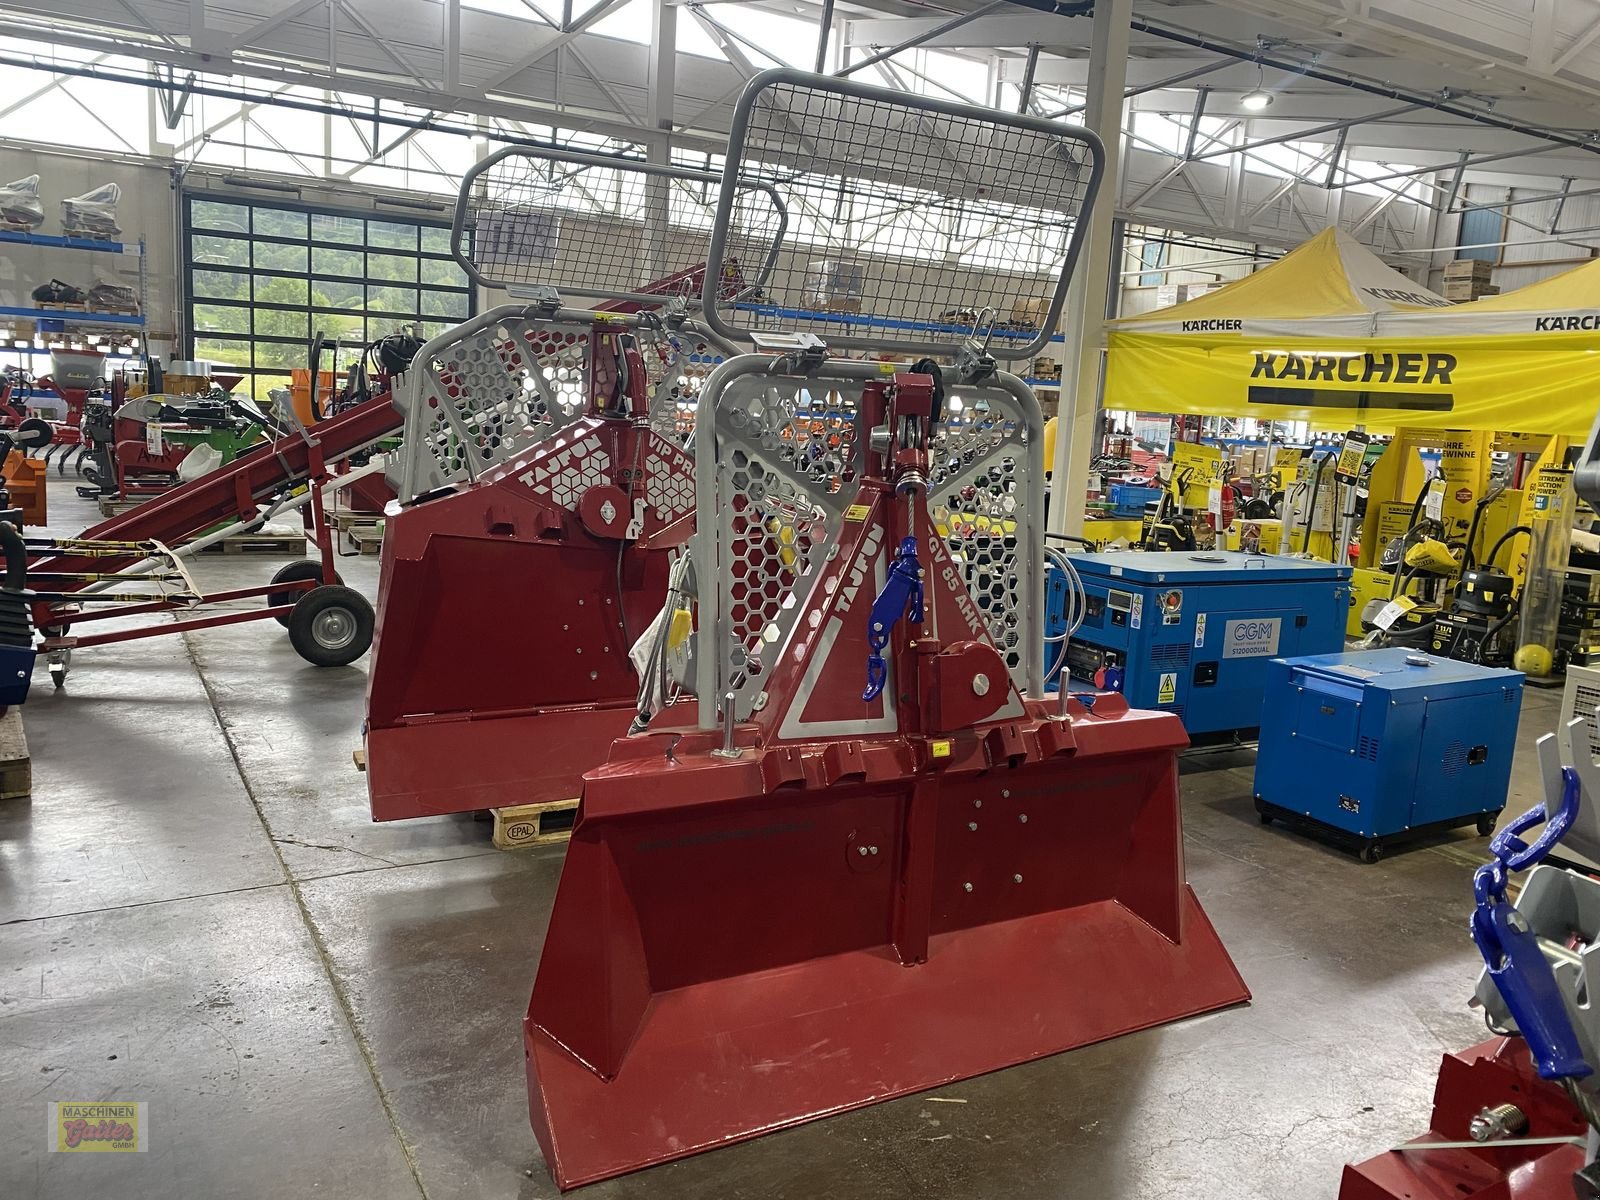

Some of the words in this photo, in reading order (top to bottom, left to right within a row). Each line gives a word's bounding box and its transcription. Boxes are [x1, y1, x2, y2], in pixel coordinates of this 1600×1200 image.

[1182, 319, 1243, 332] KÄRCHER
[648, 433, 672, 457] VIP
[518, 433, 602, 488] TAJFUN
[834, 522, 885, 613] TAJFUN
[942, 566, 959, 591] 85
[955, 594, 982, 635] AHK
[1234, 622, 1273, 641] CGM
[511, 825, 531, 838] EPAL
